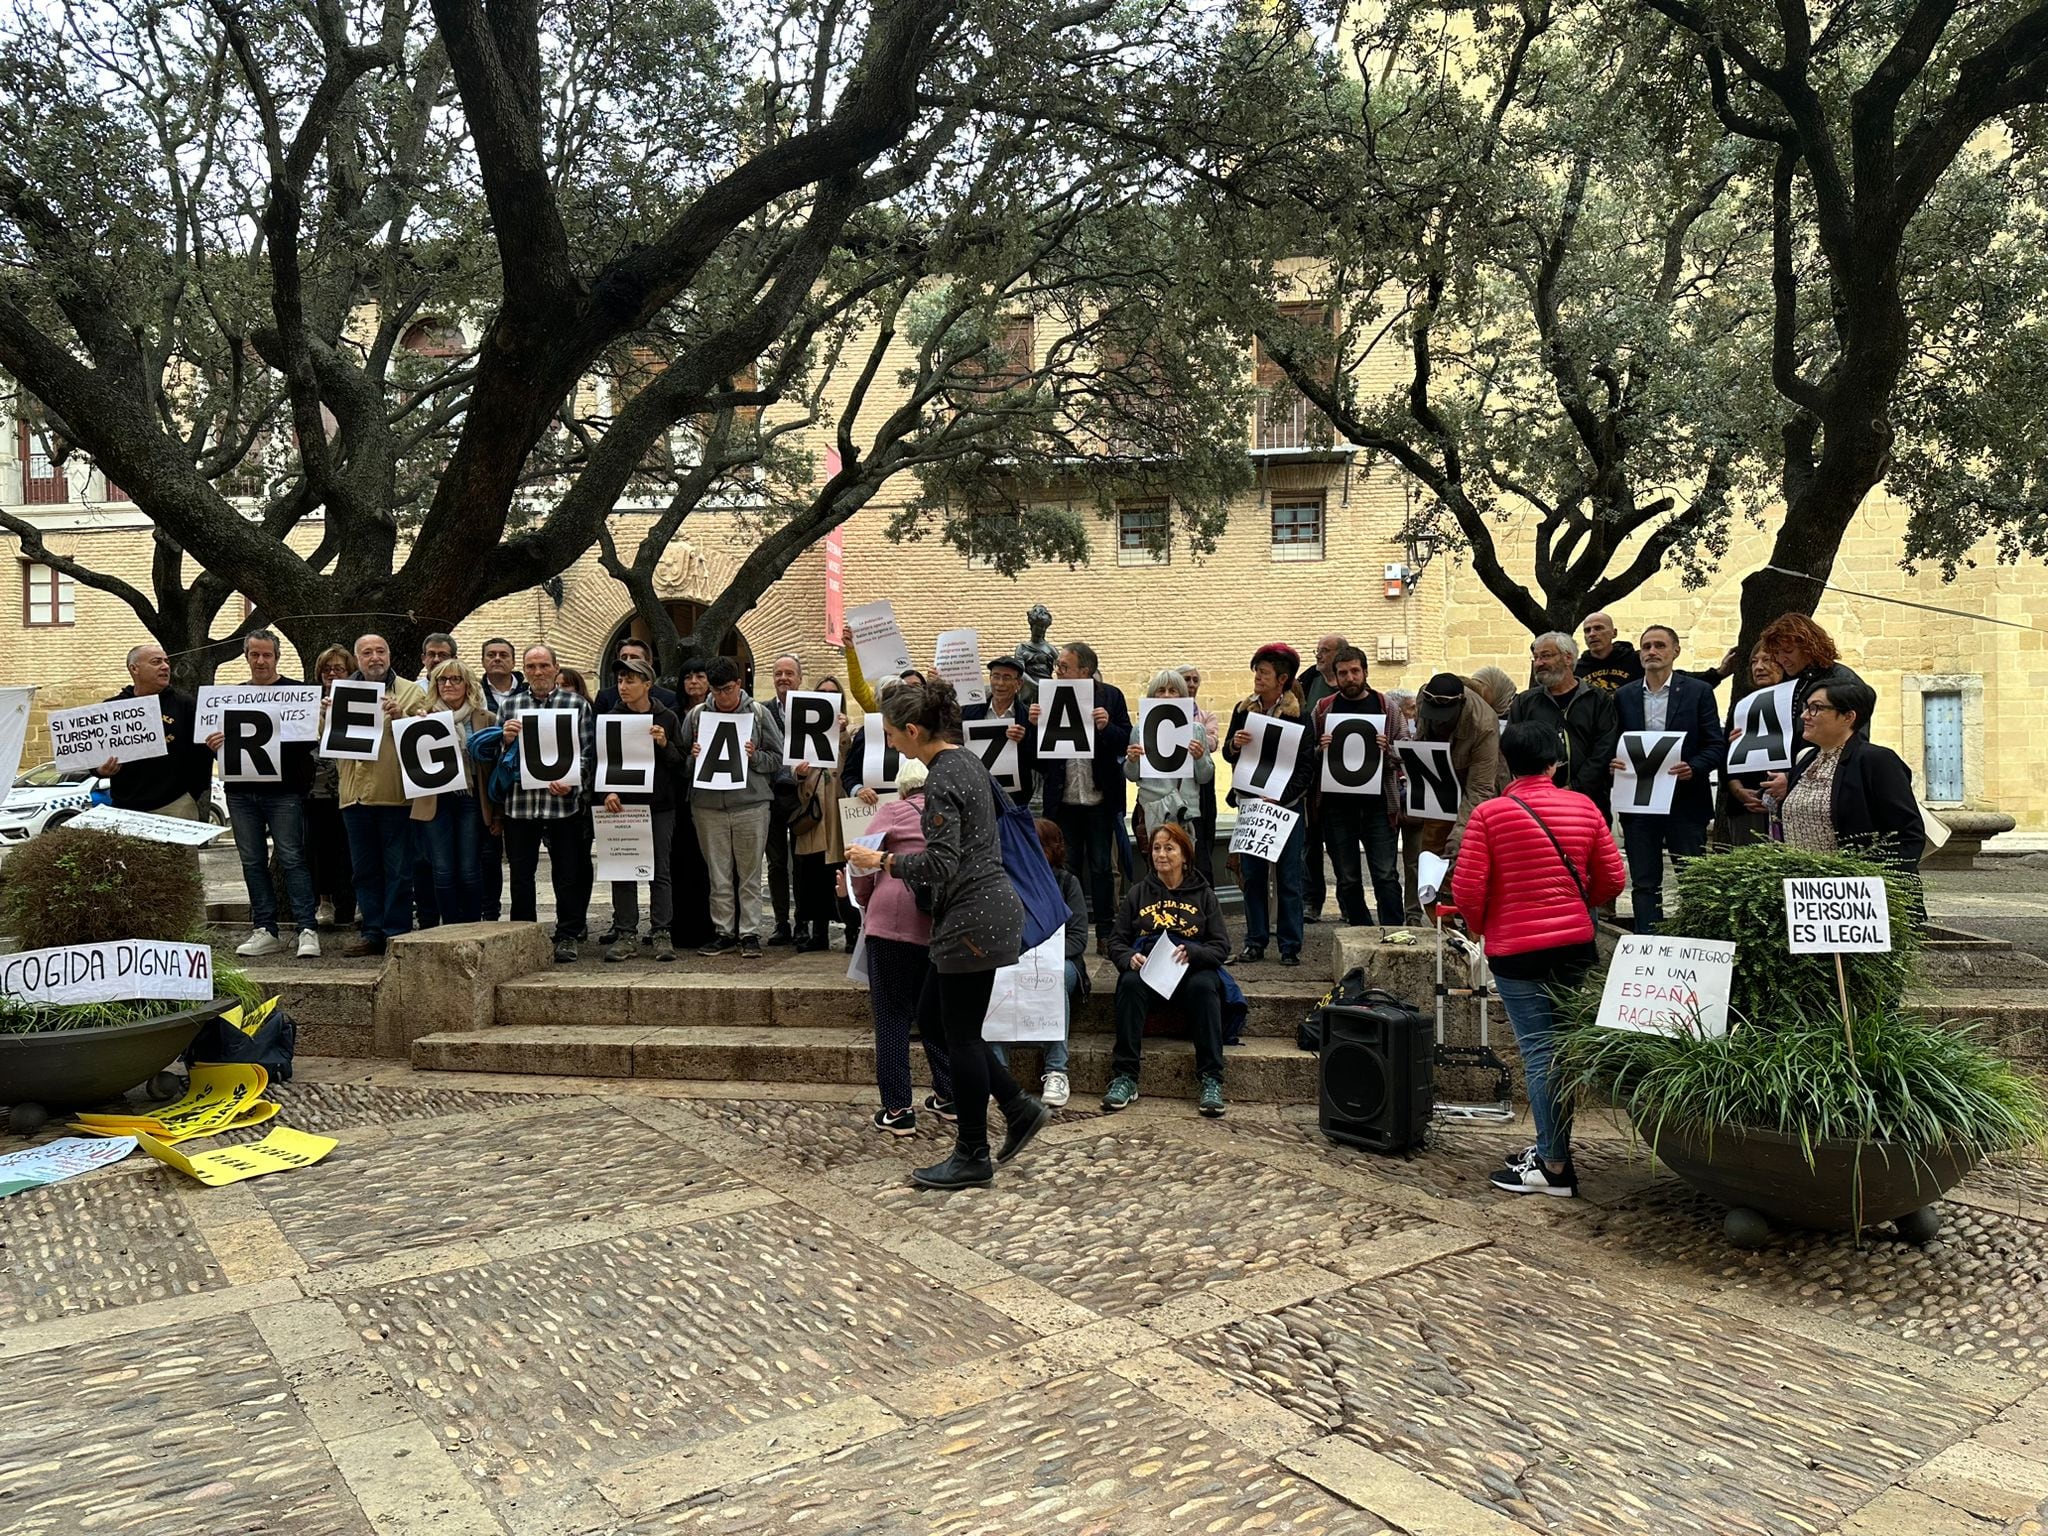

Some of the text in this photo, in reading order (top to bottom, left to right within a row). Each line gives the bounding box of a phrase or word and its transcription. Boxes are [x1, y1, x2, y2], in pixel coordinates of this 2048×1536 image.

[52, 707, 145, 731] SI VIENEN RICOS
[56, 721, 146, 744] TURISMO, SI NO,
[56, 742, 92, 756] ABUSO
[98, 740, 105, 749] Y
[110, 732, 156, 748] RACISMO
[224, 710, 278, 775] R
[327, 687, 377, 753] E
[522, 715, 573, 781] U
[790, 697, 835, 761] R
[1040, 687, 1090, 751] A
[1144, 704, 1188, 772] C
[1729, 691, 1787, 765] A
[400, 720, 459, 788] G
[605, 721, 645, 785] L
[697, 722, 744, 782] A
[969, 725, 1014, 787] Z
[1250, 723, 1283, 789] I
[1327, 718, 1380, 788] O
[1398, 747, 1459, 814] N
[1624, 736, 1680, 806] Y
[1261, 833, 1276, 845] ES
[1791, 881, 1871, 900] NINGUNA
[1794, 902, 1877, 921] PERSONA
[1621, 943, 1731, 964] YO NO ME INTEGRO
[1793, 924, 1884, 943] ES ILEGAL
[0, 945, 208, 997] COGIDA DIGNA YA
[1621, 982, 1699, 1006] ESPAÑA
[1635, 966, 1697, 983] EN UNA
[1618, 1004, 1695, 1033] RACISTA
